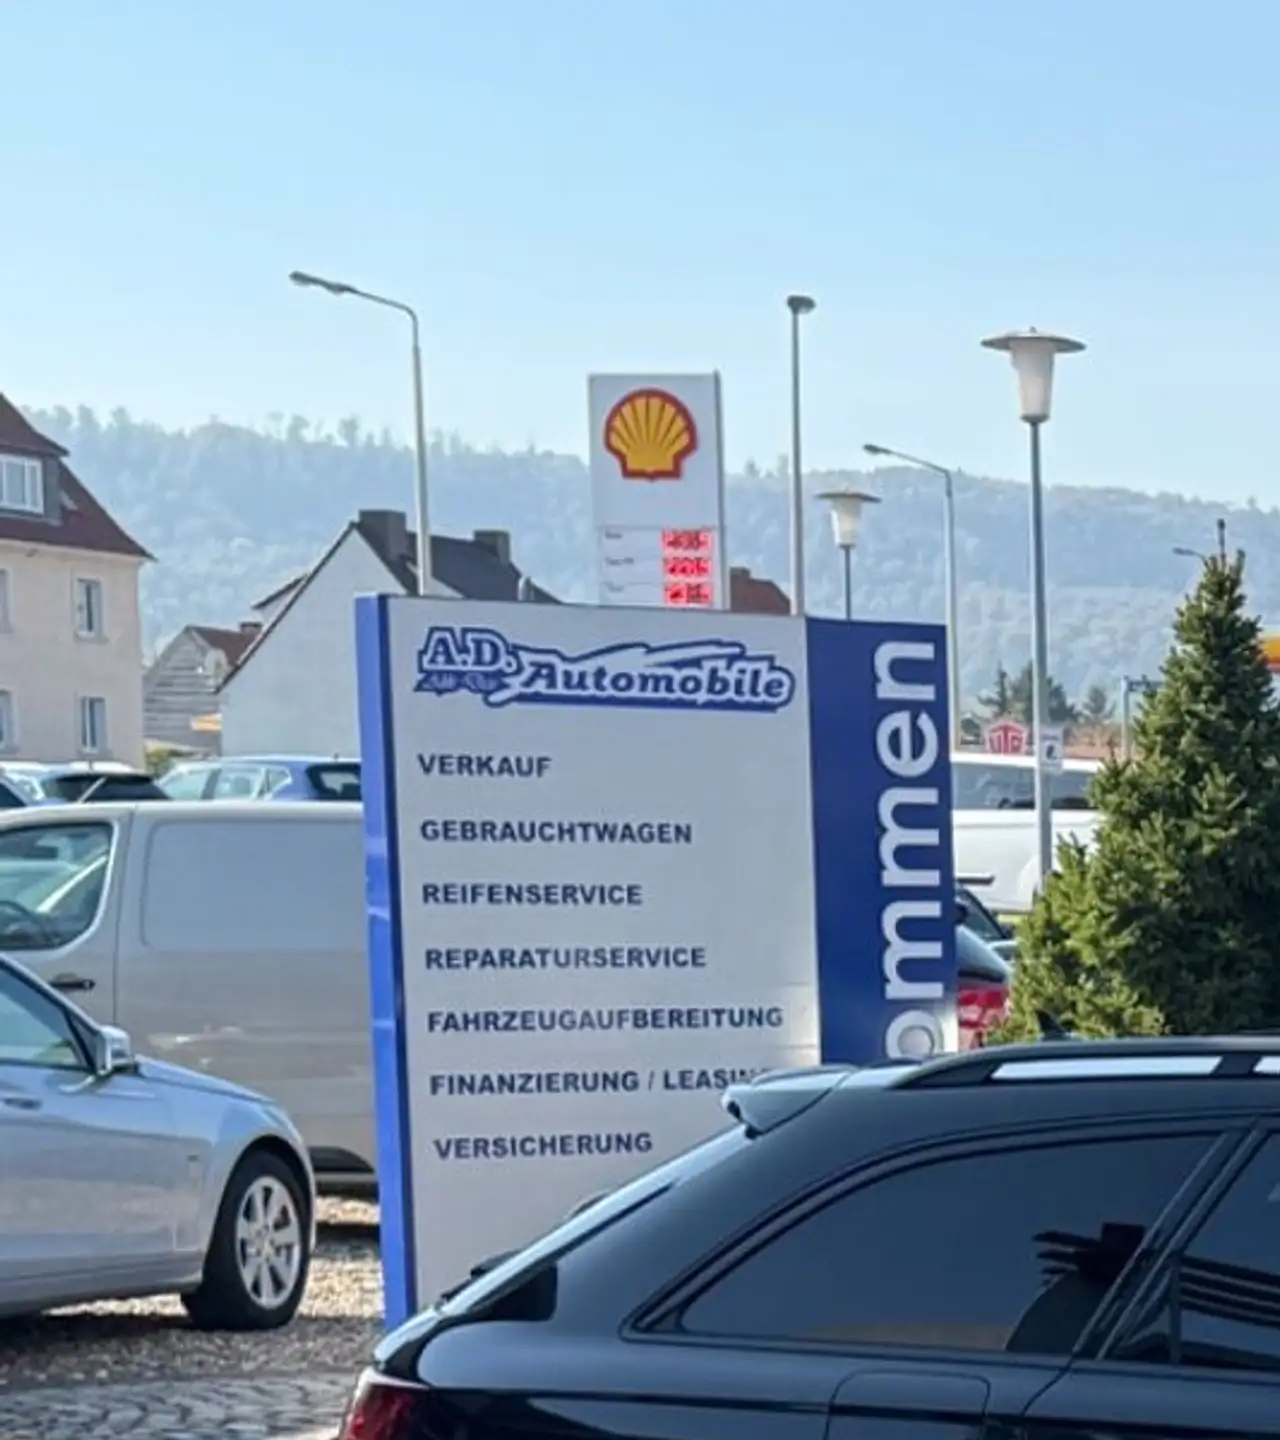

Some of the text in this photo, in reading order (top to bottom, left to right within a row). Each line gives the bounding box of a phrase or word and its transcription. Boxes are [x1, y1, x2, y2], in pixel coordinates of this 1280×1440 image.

[517, 657, 788, 703] Automobile
[417, 752, 552, 779] VERKAUF
[419, 818, 693, 845] GEBRAUCHTWAGEN
[421, 883, 643, 906] REIFENSERVICE
[423, 946, 707, 970] REPARATURSERVICE
[426, 1006, 784, 1033] FAHRZEUGAUFBEREITUNG
[428, 1069, 640, 1096] FINANZIERUNG
[662, 1068, 770, 1091] LEASI
[433, 1131, 653, 1160] VERSICHERUNG
